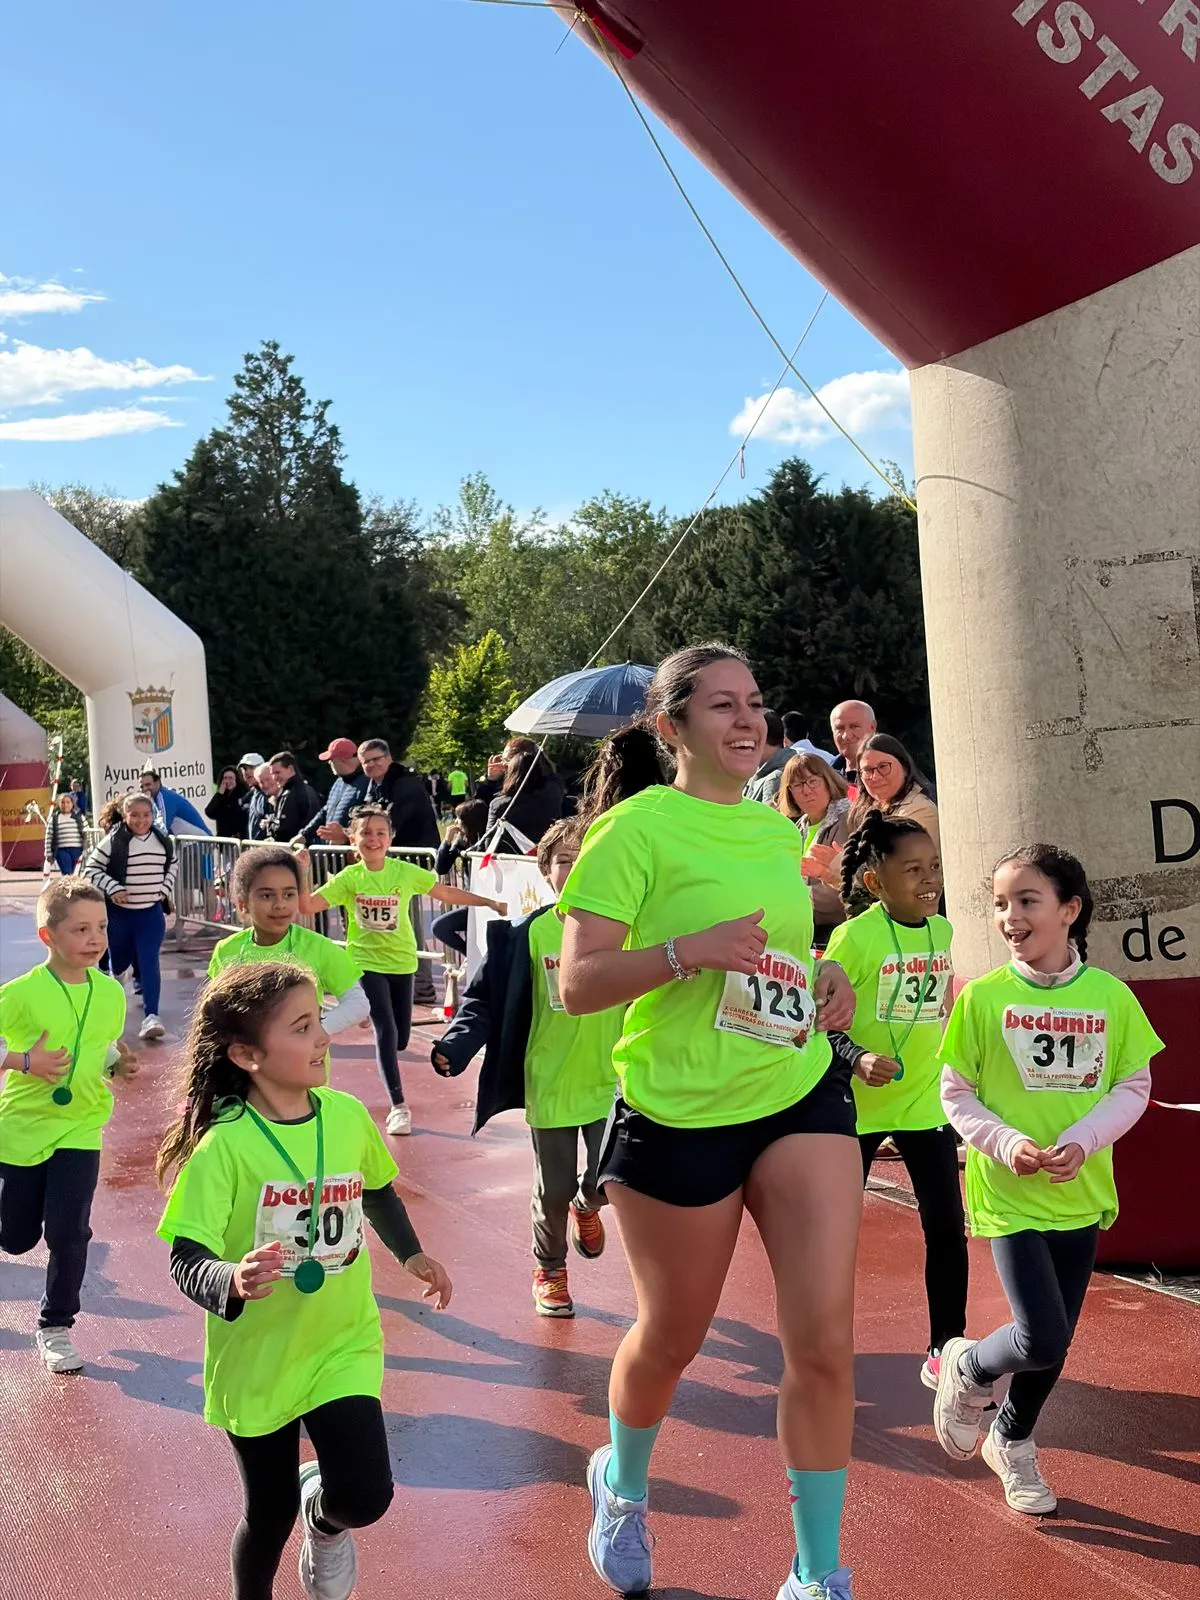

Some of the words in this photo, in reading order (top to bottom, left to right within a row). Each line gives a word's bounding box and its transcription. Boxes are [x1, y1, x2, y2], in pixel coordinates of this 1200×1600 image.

[104, 761, 205, 784] Ayunmiento
[361, 906, 391, 922] 315
[1122, 911, 1187, 963] de
[756, 954, 806, 989] dunia
[905, 974, 938, 1003] 32
[747, 975, 804, 1022] 123
[1005, 1010, 1105, 1033] bedunia
[1033, 1033, 1076, 1068] 31
[295, 1206, 344, 1248] 30
